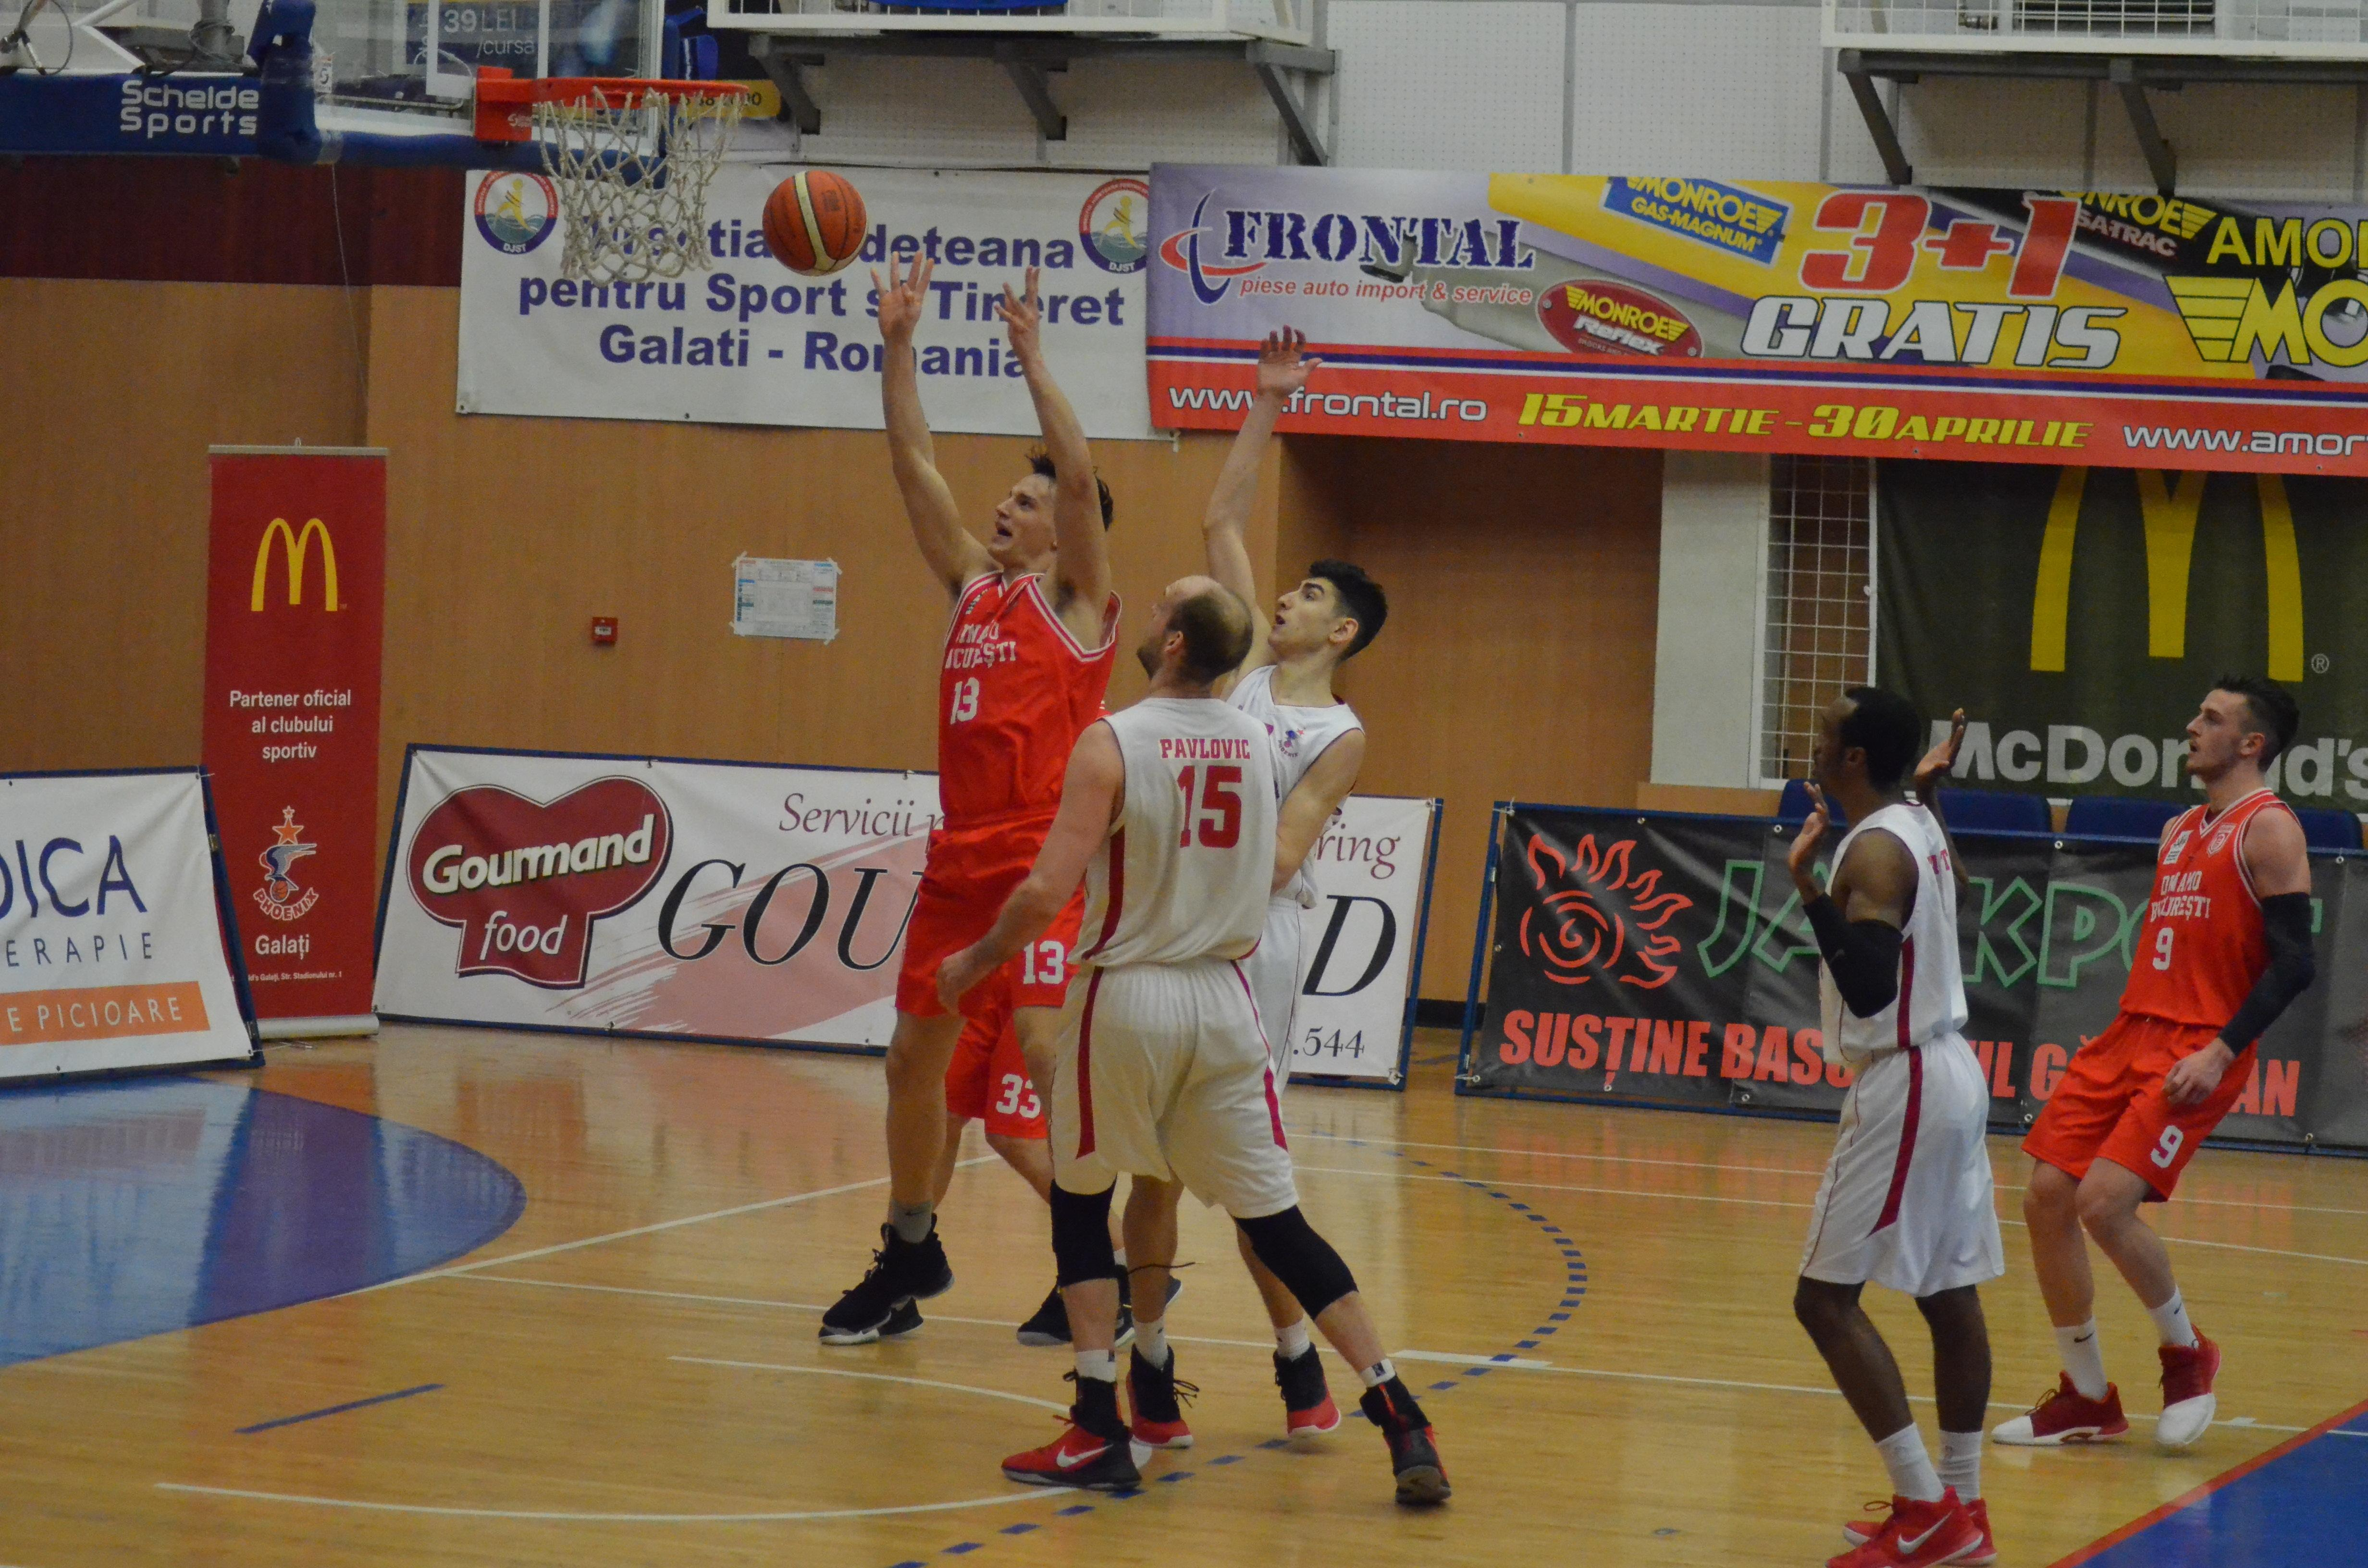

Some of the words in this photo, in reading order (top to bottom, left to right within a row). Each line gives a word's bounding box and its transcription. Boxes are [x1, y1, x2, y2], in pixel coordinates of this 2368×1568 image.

[444, 9, 477, 33] 39
[121, 80, 259, 109] Schelde
[121, 107, 257, 139] Sports
[1223, 209, 1535, 270] FRONTAL
[1631, 196, 1759, 252] GAS-MAGNUM
[1109, 262, 1135, 272] DJST
[519, 275, 685, 315] pentru
[706, 272, 847, 322] Sport
[1240, 277, 1296, 298] piese
[1302, 280, 1349, 297] auto
[1355, 280, 1425, 302] import
[1454, 285, 1533, 305] service
[1576, 292, 1670, 341] MONROE
[1741, 295, 2128, 369] GRATIS
[599, 324, 749, 367] Galati
[230, 690, 300, 707] Partener
[303, 689, 351, 707] oficial
[950, 677, 979, 725] 13
[251, 716, 266, 733] al
[271, 715, 333, 733] clubului
[262, 741, 317, 763] sportiv
[1159, 738, 1250, 759] PAVLOVIC
[779, 793, 914, 836] Servicii
[1177, 765, 1242, 849] 15
[422, 814, 654, 894] Gourmand
[253, 887, 319, 921] PHOENIX
[480, 911, 567, 960] food
[2153, 927, 2173, 970] 9
[1023, 940, 1064, 985] 13
[37, 997, 182, 1029] PICIOARE
[996, 1073, 1041, 1119] 33
[2150, 1125, 2184, 1169] 9
